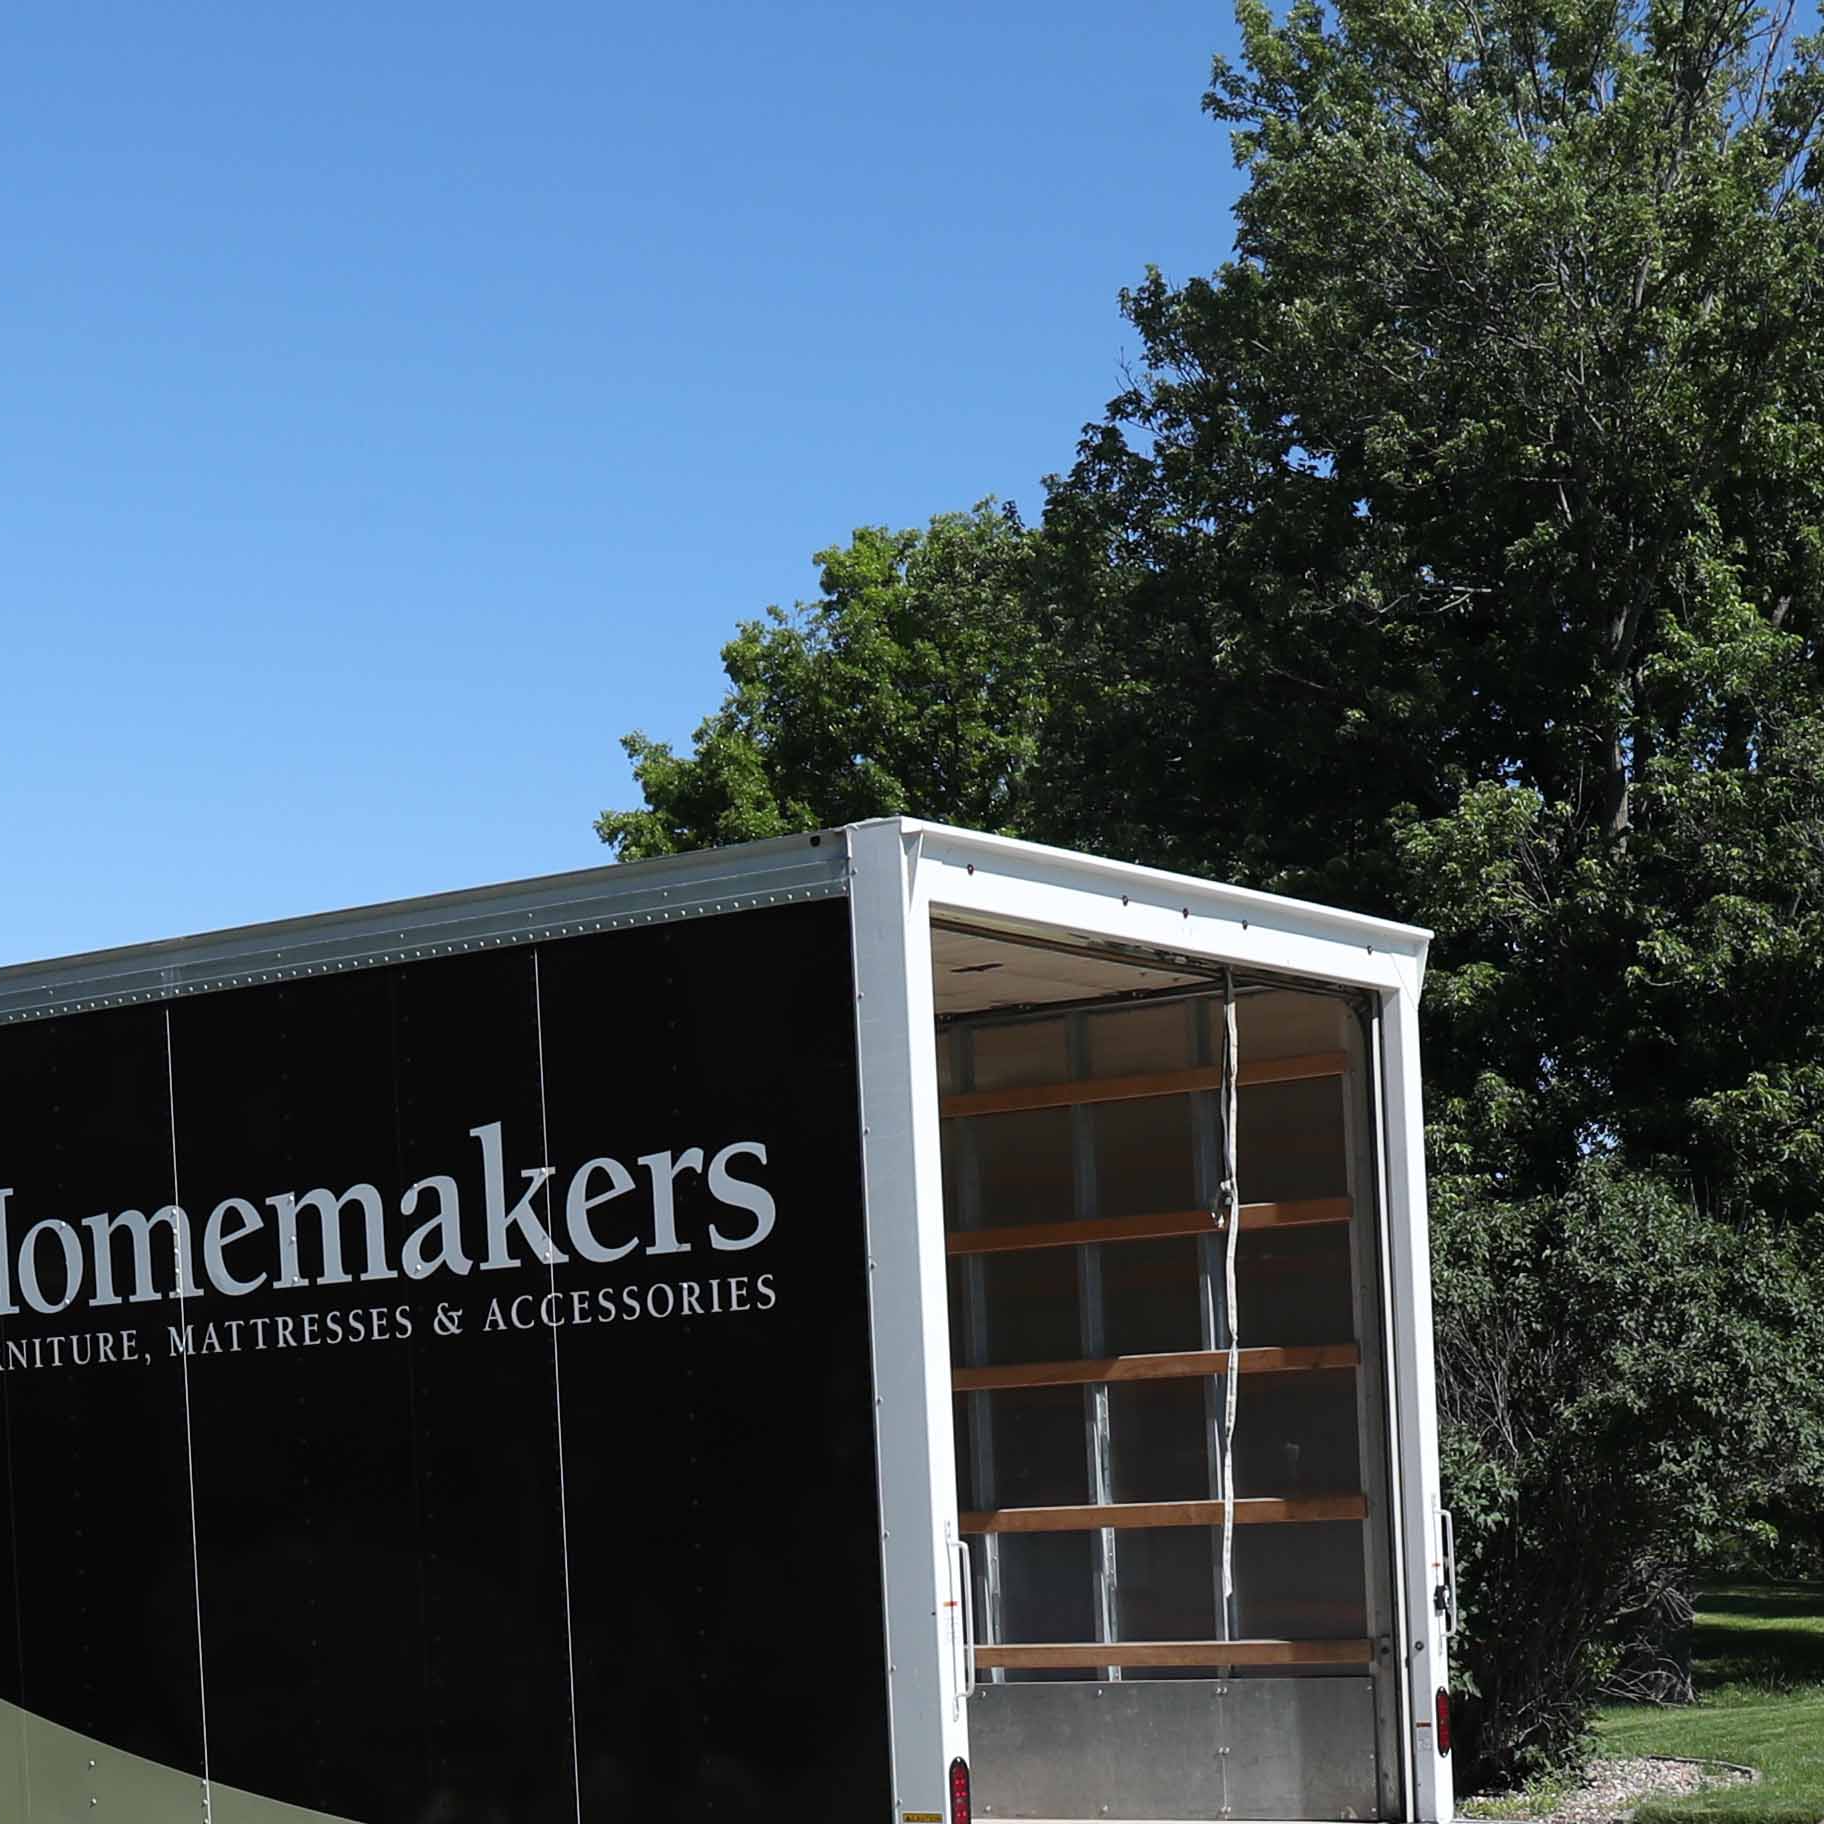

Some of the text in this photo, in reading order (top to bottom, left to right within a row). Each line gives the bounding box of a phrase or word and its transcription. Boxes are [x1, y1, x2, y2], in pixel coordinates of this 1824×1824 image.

[168, 1304, 413, 1357] MATTRESSES
[432, 1301, 464, 1336] &
[482, 1273, 776, 1332] ACCESSORIES
